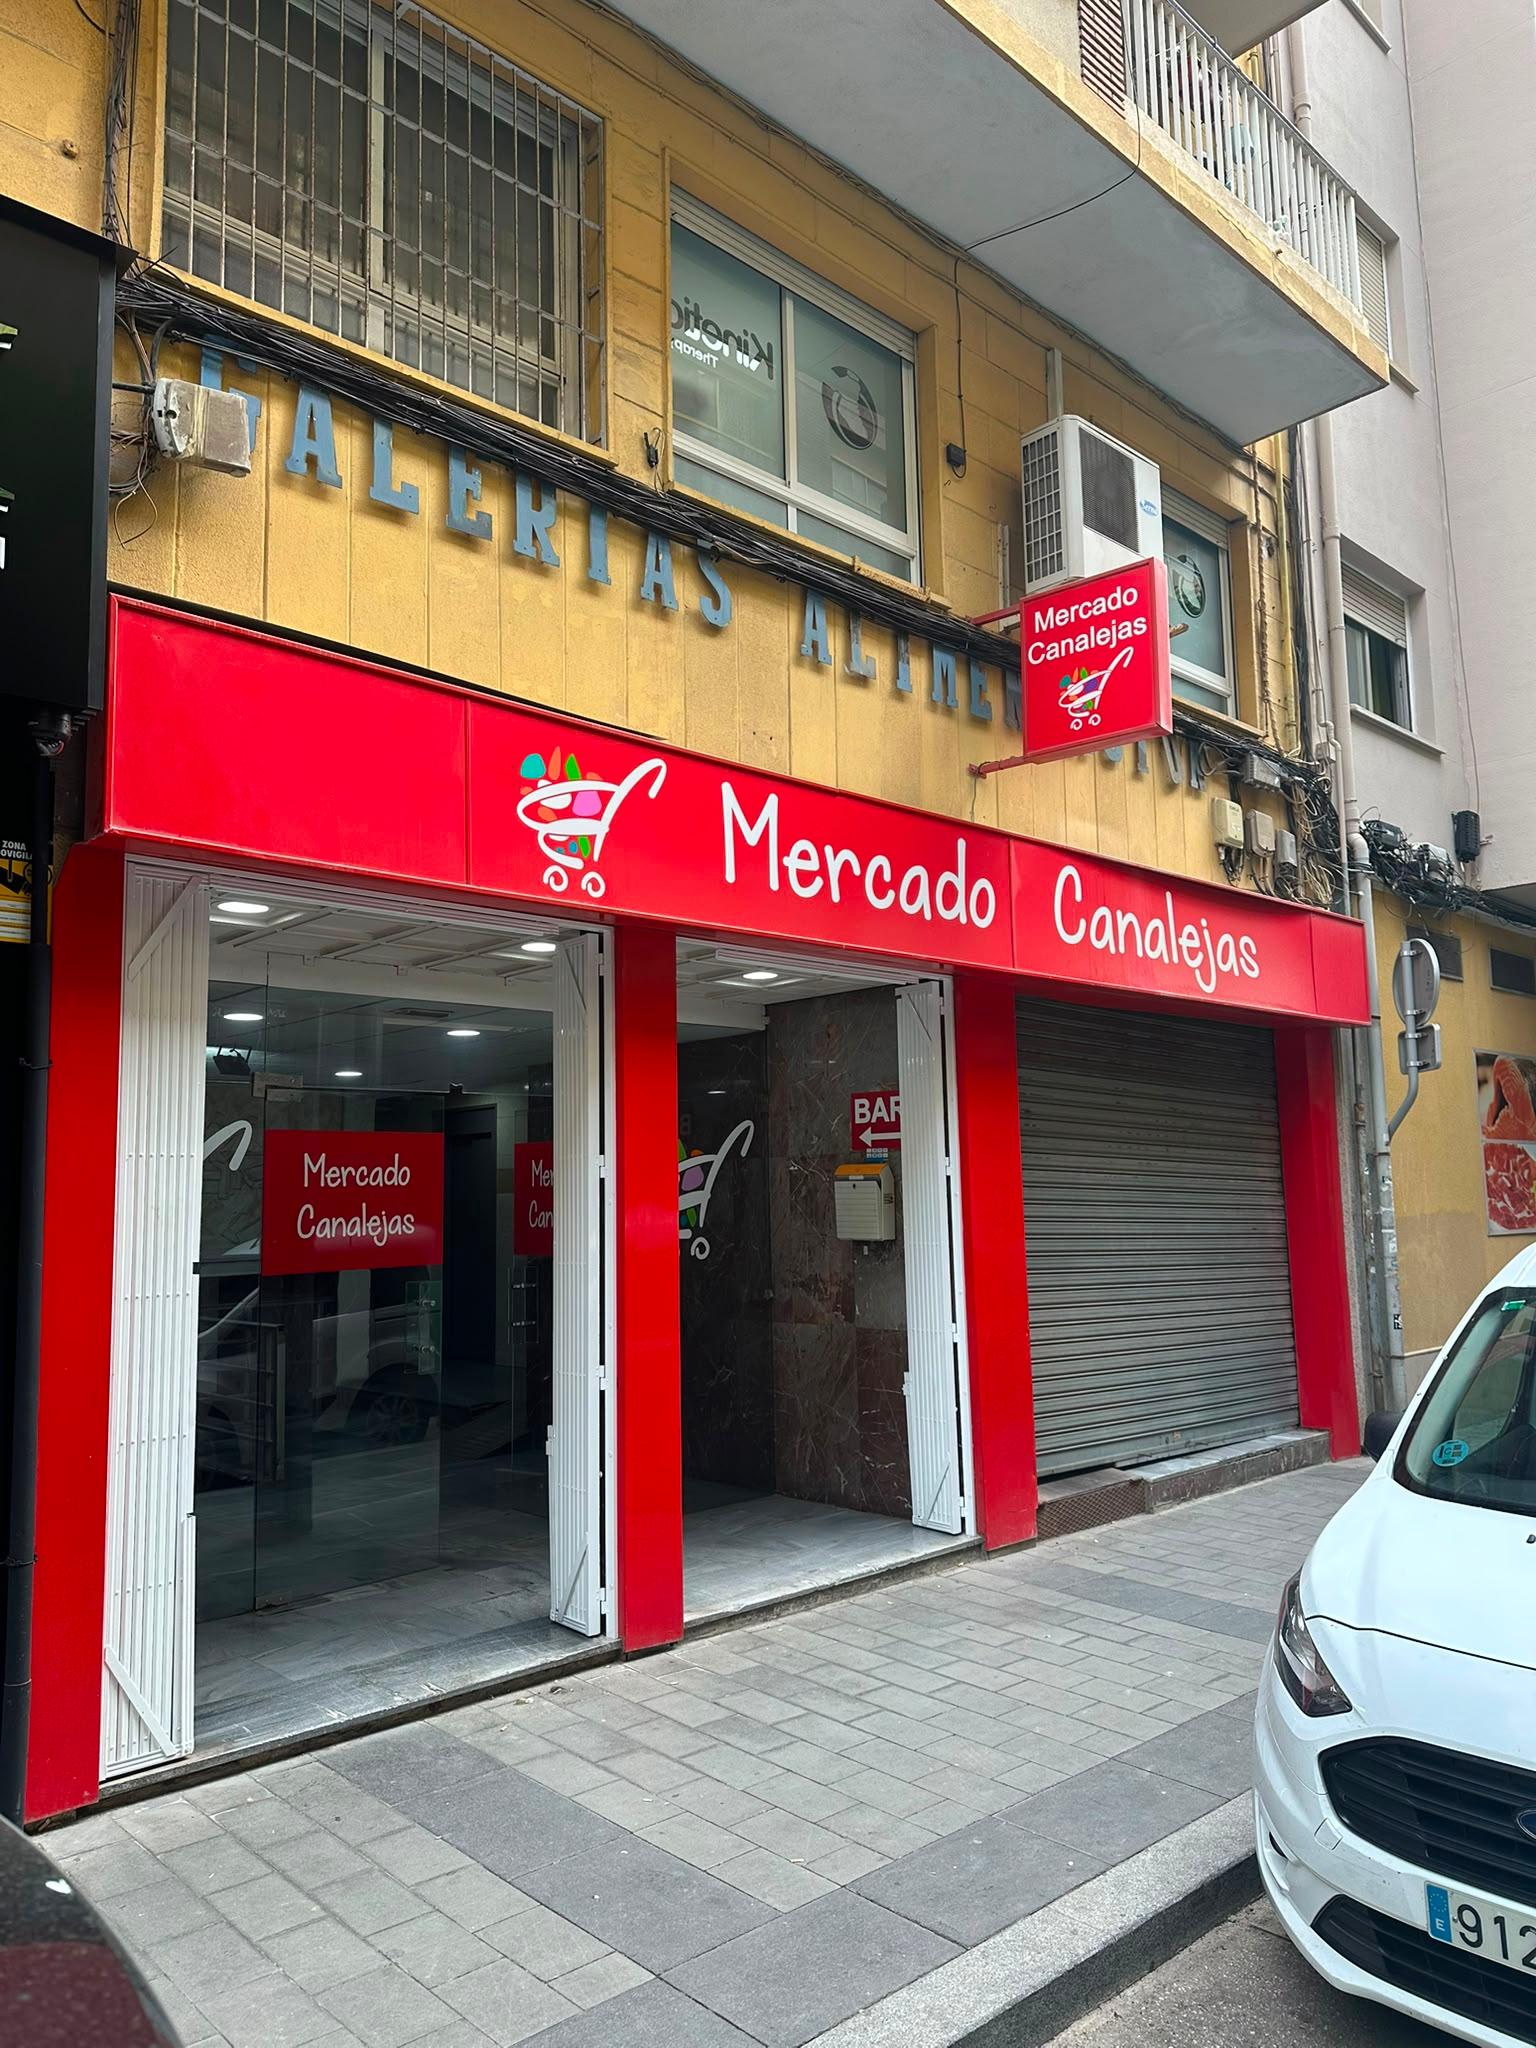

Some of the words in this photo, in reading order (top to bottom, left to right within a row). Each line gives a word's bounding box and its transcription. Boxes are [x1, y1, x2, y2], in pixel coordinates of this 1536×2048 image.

[1034, 586, 1138, 634] Mercado
[1027, 616, 1148, 665] Canalejas
[2, 840, 26, 851] ZONA
[721, 781, 997, 930] Mercado
[1053, 865, 1261, 994] Canalejas
[303, 1152, 411, 1188] Mercado
[297, 1202, 415, 1247] Canalejas
[1435, 1918, 1446, 1932] E
